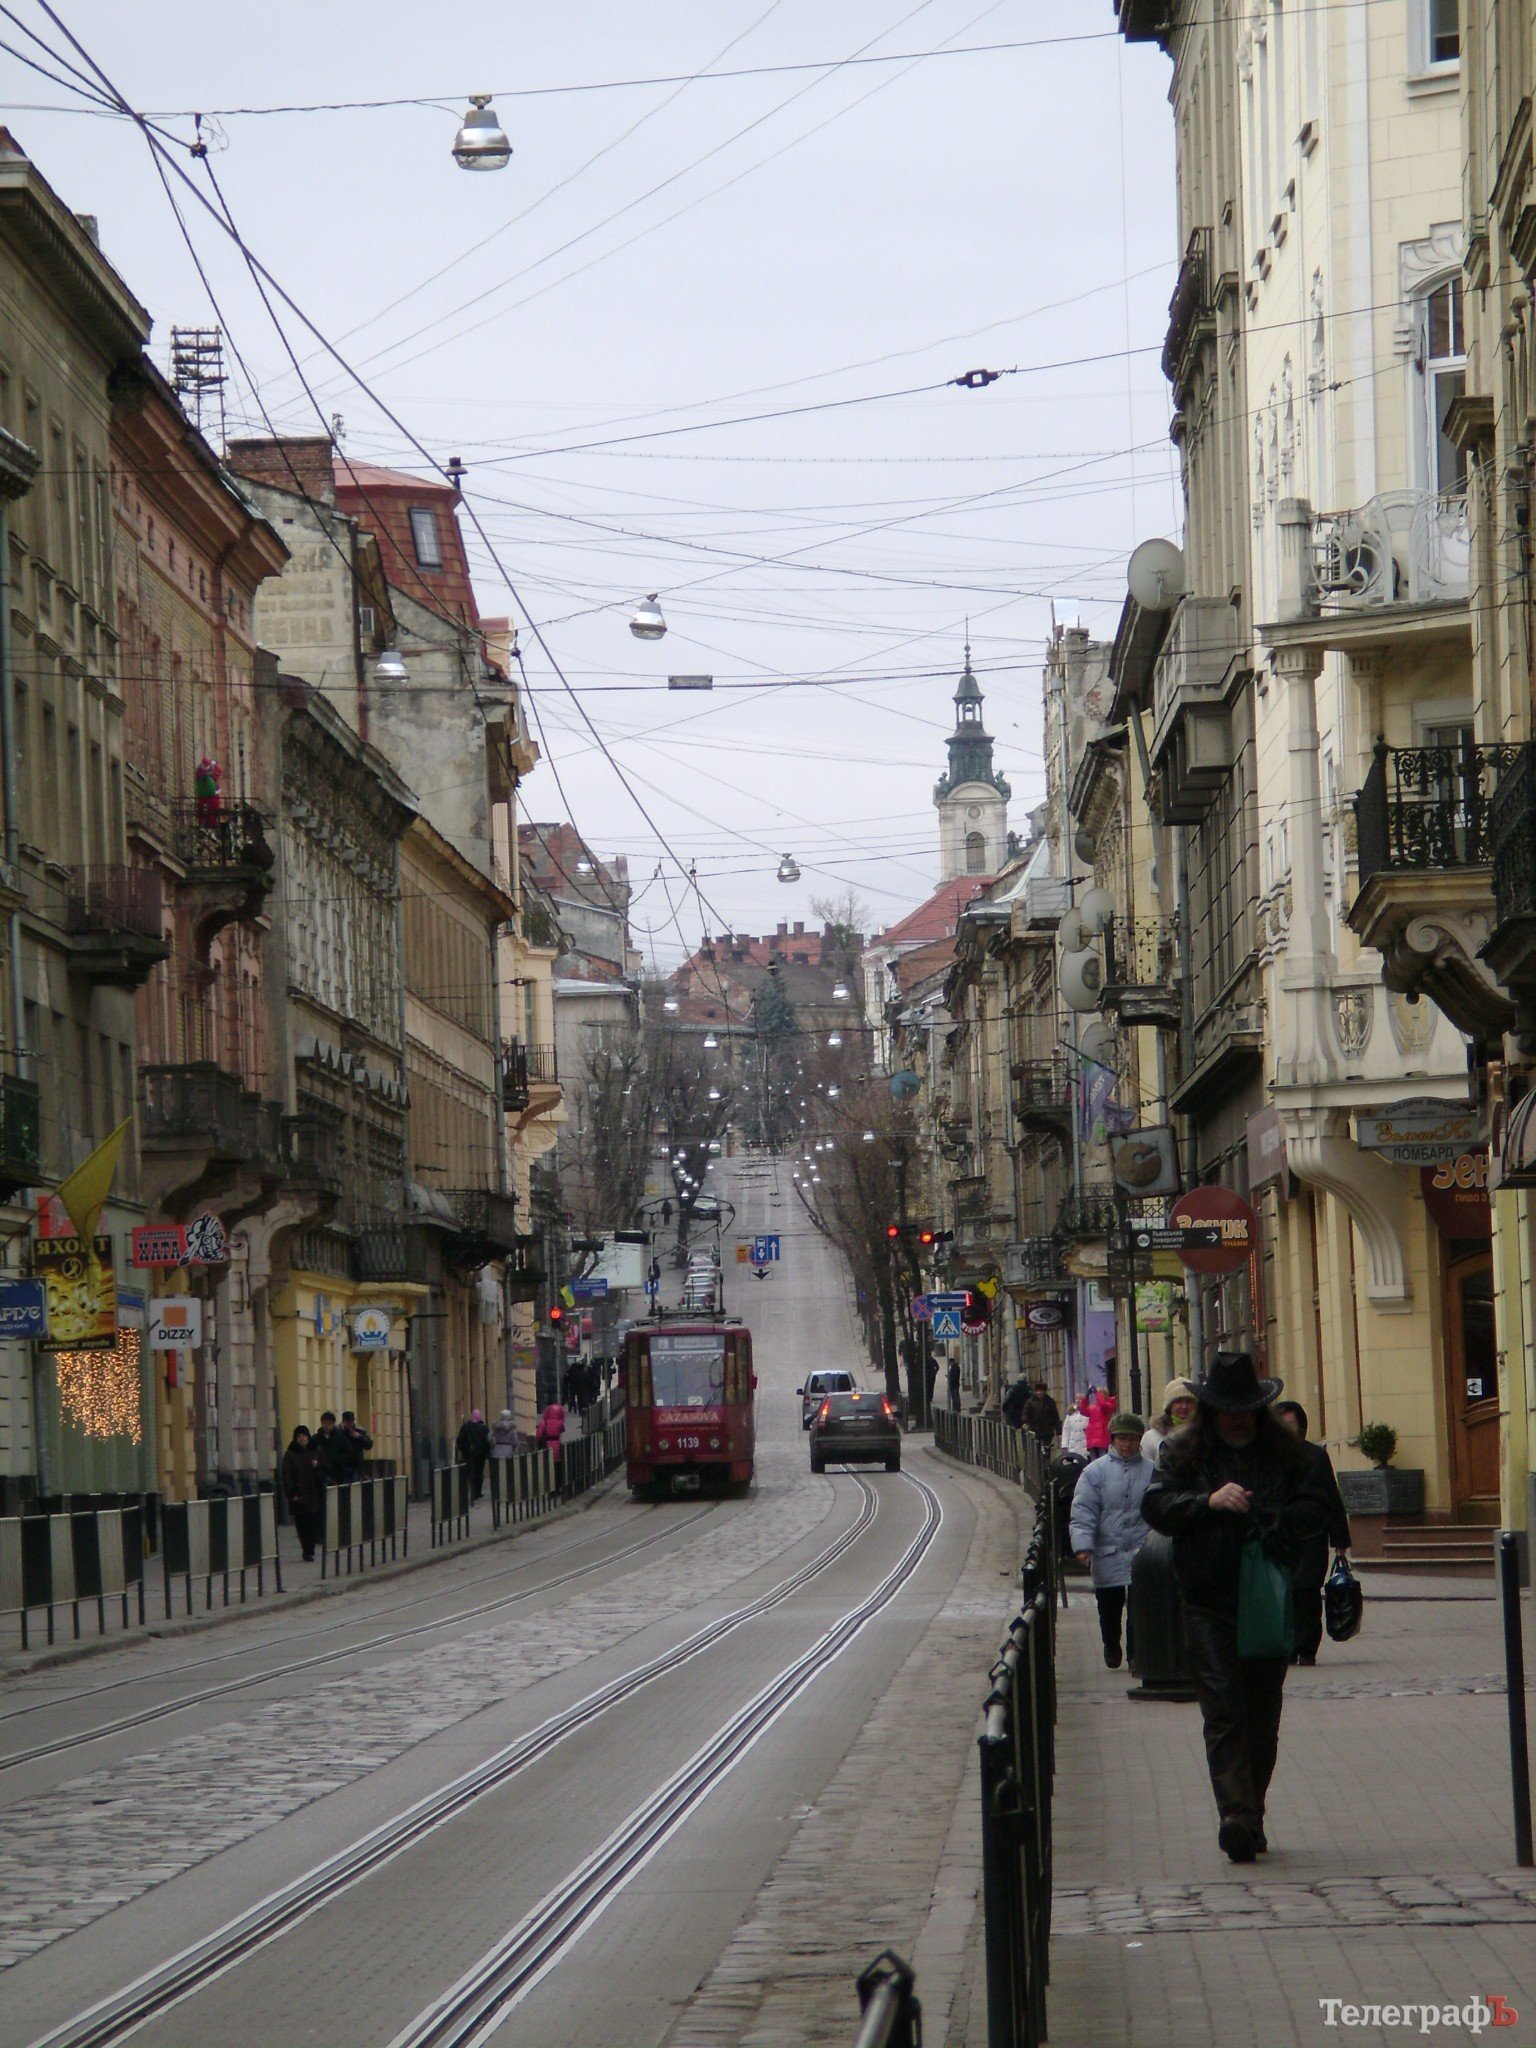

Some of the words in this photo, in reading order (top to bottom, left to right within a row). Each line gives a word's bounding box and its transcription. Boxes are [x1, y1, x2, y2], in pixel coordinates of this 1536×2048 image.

[1393, 1146, 1455, 1160] ЛОМБАРД
[36, 1237, 109, 1255] ЯХОТ
[138, 1241, 181, 1261] ХАТА
[158, 1329, 195, 1340] DIZZY
[677, 1436, 700, 1449] 1139
